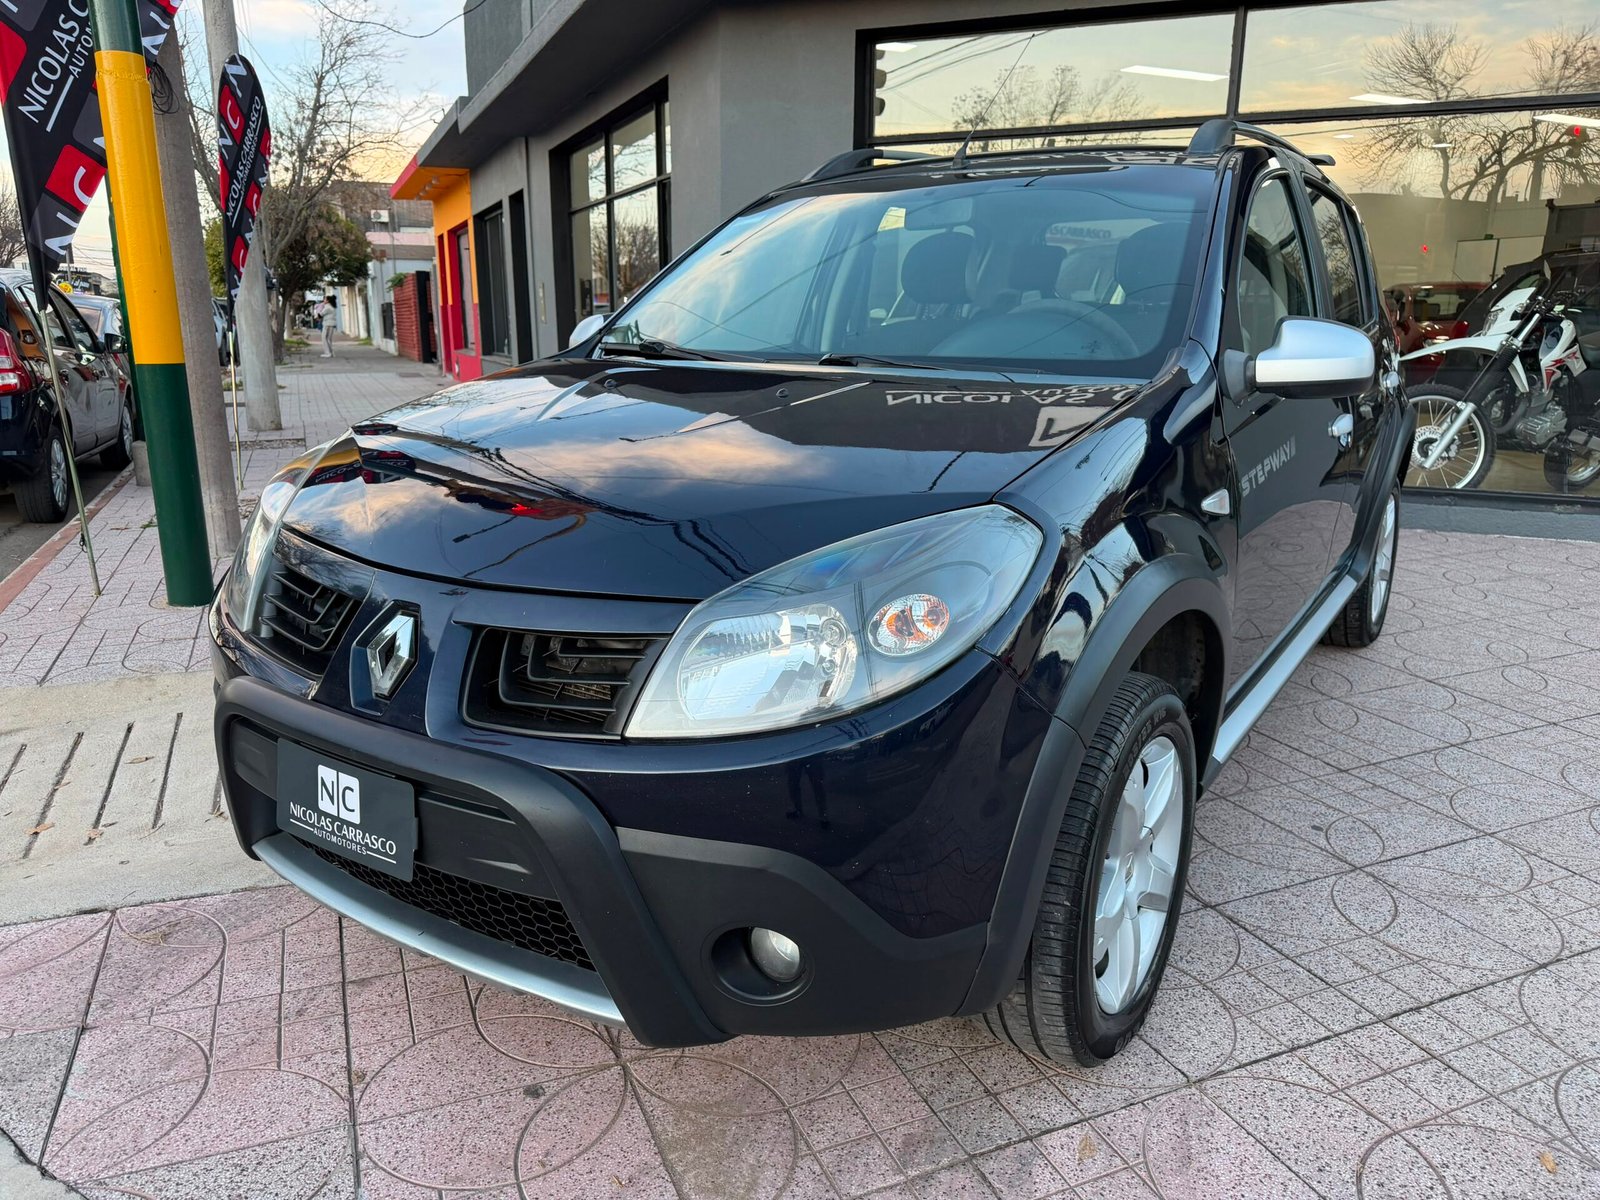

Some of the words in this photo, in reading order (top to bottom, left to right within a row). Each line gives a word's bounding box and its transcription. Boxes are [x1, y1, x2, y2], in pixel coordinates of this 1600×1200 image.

[18, 13, 80, 123] NICOLAS
[226, 161, 245, 222] NICOLAS
[240, 95, 261, 165] CARRASCO
[1240, 439, 1290, 498] STEPWAY
[289, 801, 333, 833] NICOLAS
[333, 821, 397, 856] CARRASCO
[312, 827, 368, 856] AUTOMOTORES
